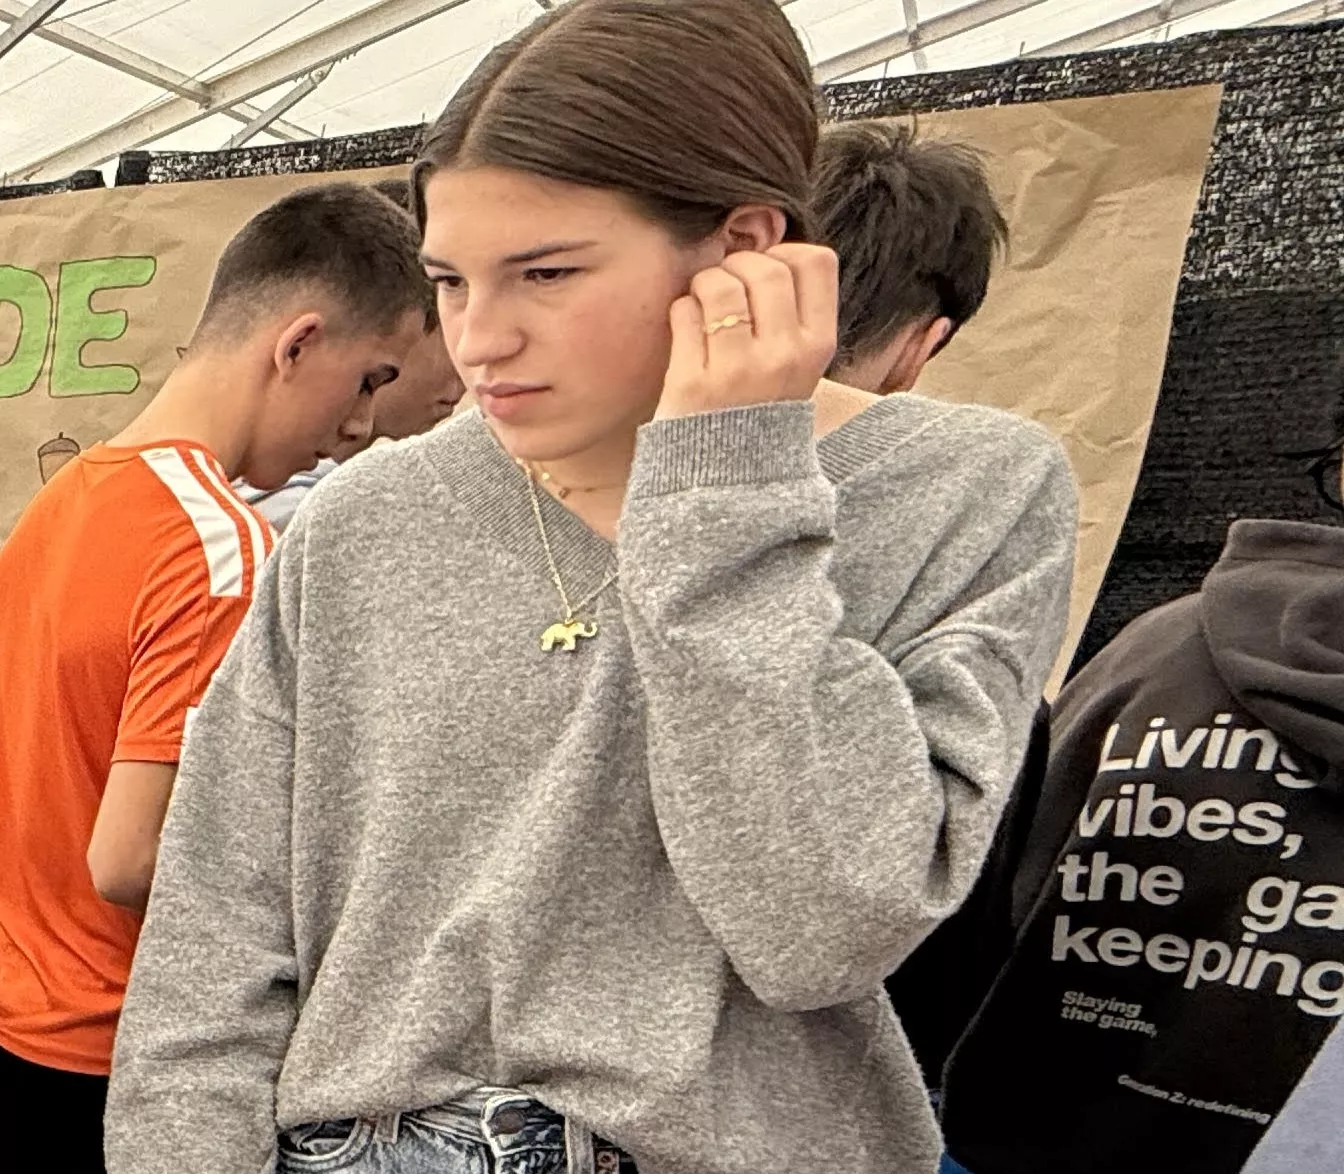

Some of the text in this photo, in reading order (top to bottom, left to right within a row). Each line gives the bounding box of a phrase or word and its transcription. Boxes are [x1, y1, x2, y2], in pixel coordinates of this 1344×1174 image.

[1077, 783, 1304, 859] vibes,
[1057, 852, 1344, 934] the ga
[1051, 915, 1344, 1018] keeping
[1060, 1005, 1098, 1022] the
